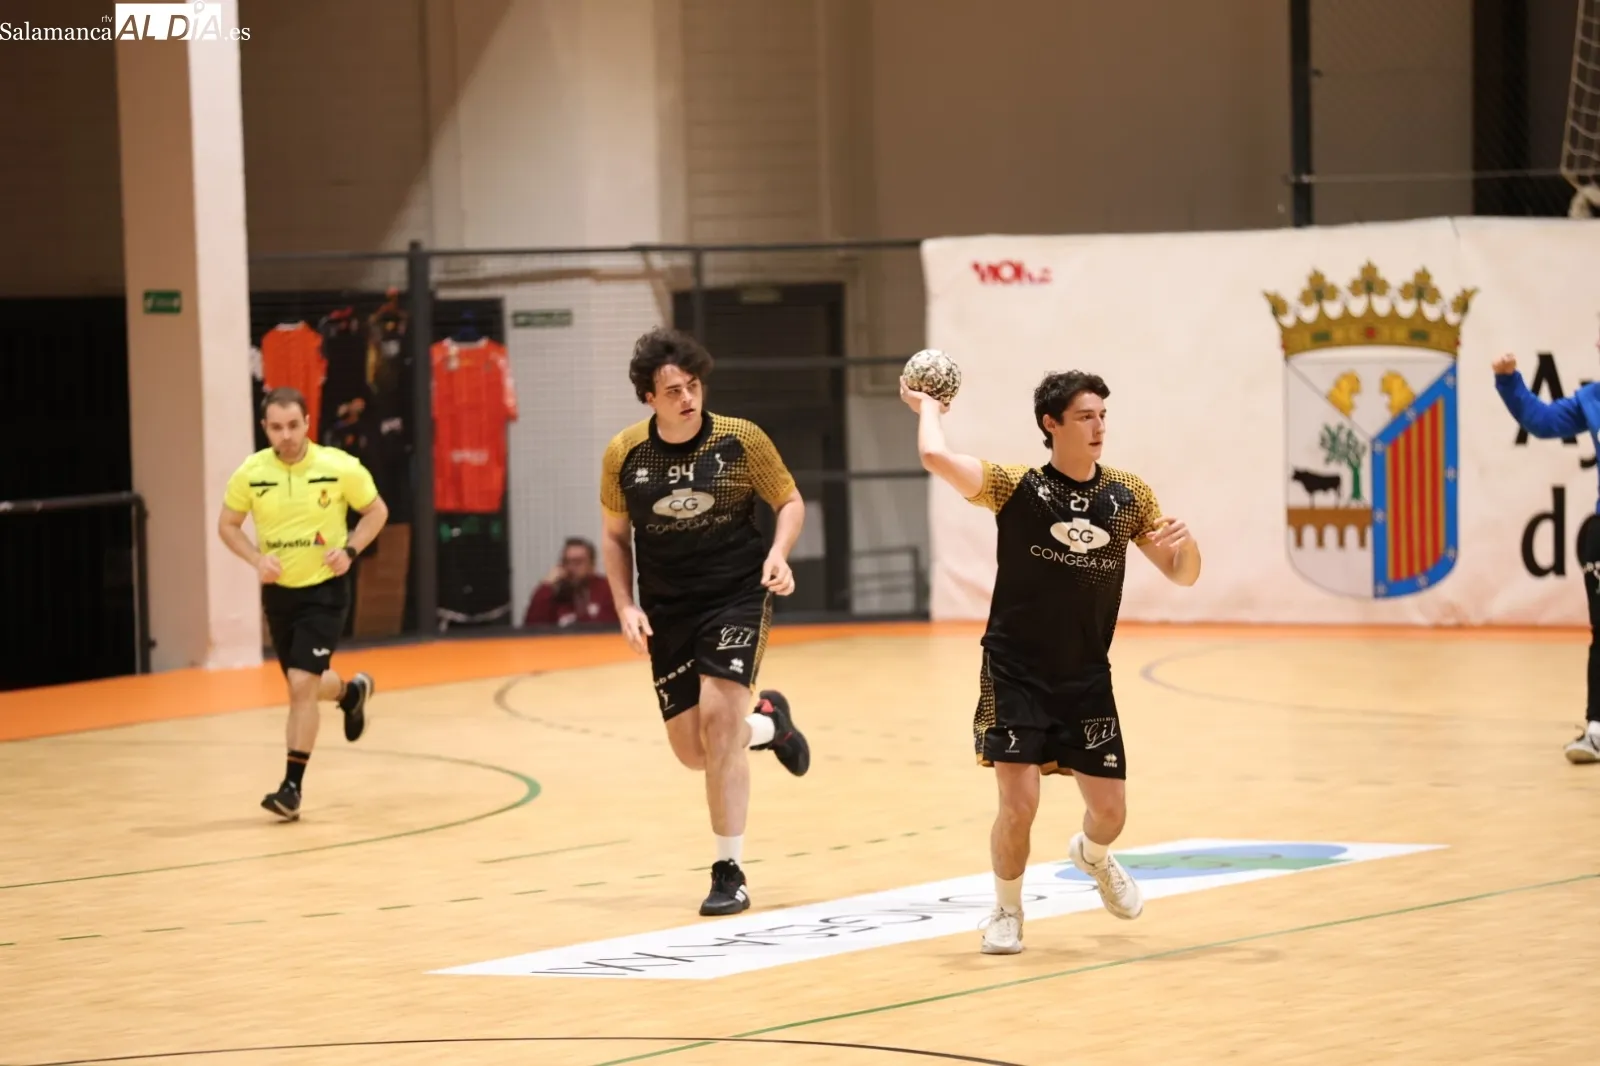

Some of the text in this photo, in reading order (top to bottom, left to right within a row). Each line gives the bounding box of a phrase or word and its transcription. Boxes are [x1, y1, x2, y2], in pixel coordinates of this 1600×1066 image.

[667, 463, 695, 484] 94
[668, 497, 699, 512] CG
[1070, 492, 1090, 512] 27
[1067, 527, 1094, 544] CG
[1030, 545, 1118, 570] CONGESA XXI
[717, 626, 755, 649] Gil
[1084, 719, 1117, 749] Gil
